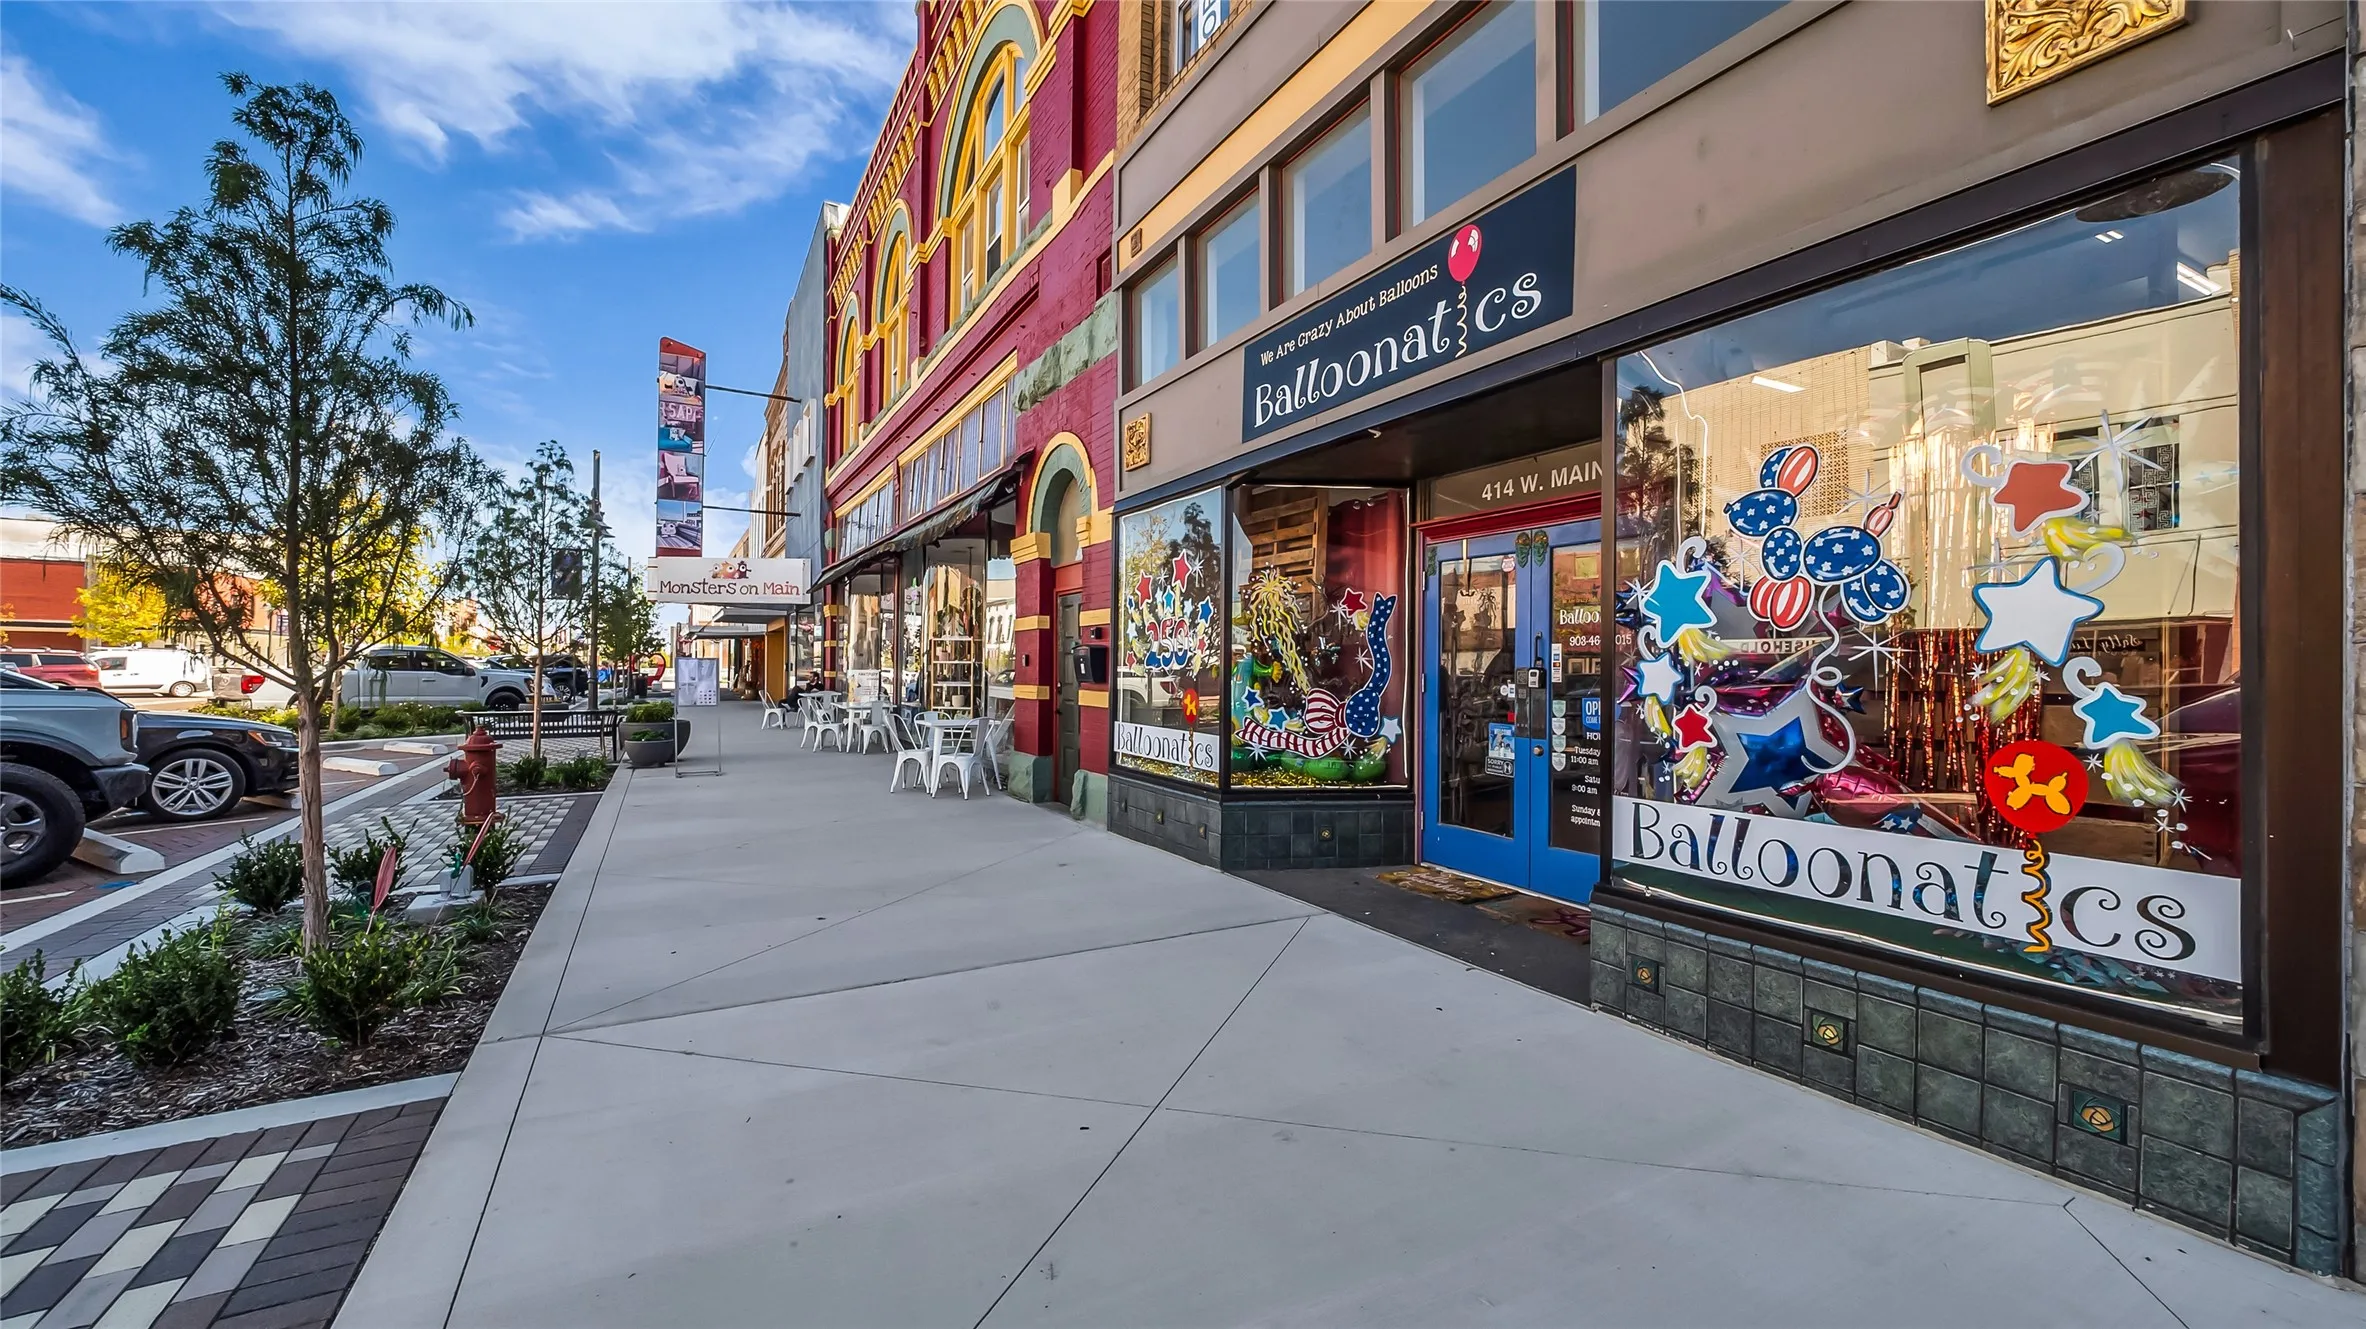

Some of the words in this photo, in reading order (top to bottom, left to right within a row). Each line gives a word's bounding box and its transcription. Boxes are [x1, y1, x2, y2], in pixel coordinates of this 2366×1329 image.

[1260, 351, 1274, 367] We
[1275, 338, 1296, 360] Are
[1298, 318, 1333, 348] Crazy
[1336, 296, 1376, 328] About
[1378, 264, 1438, 306] Balloons
[1254, 272, 1542, 428] Balloonatics
[1482, 478, 1514, 500] 414
[1520, 473, 1543, 494] W.
[1551, 460, 1602, 488] MAIN
[659, 578, 737, 595] Monsters
[739, 584, 759, 595] on
[763, 581, 800, 595] Main
[1560, 608, 1601, 625] Balloo
[1144, 617, 1190, 669] 250
[1117, 723, 1214, 768] Balloonatics
[1574, 746, 1601, 757] Tuesday
[1570, 756, 1587, 765] 11:00
[1584, 775, 1600, 784] Satu
[1571, 804, 1596, 816] Sunday
[1570, 815, 1601, 827] appointm
[1630, 802, 2197, 962] Balloonatics
